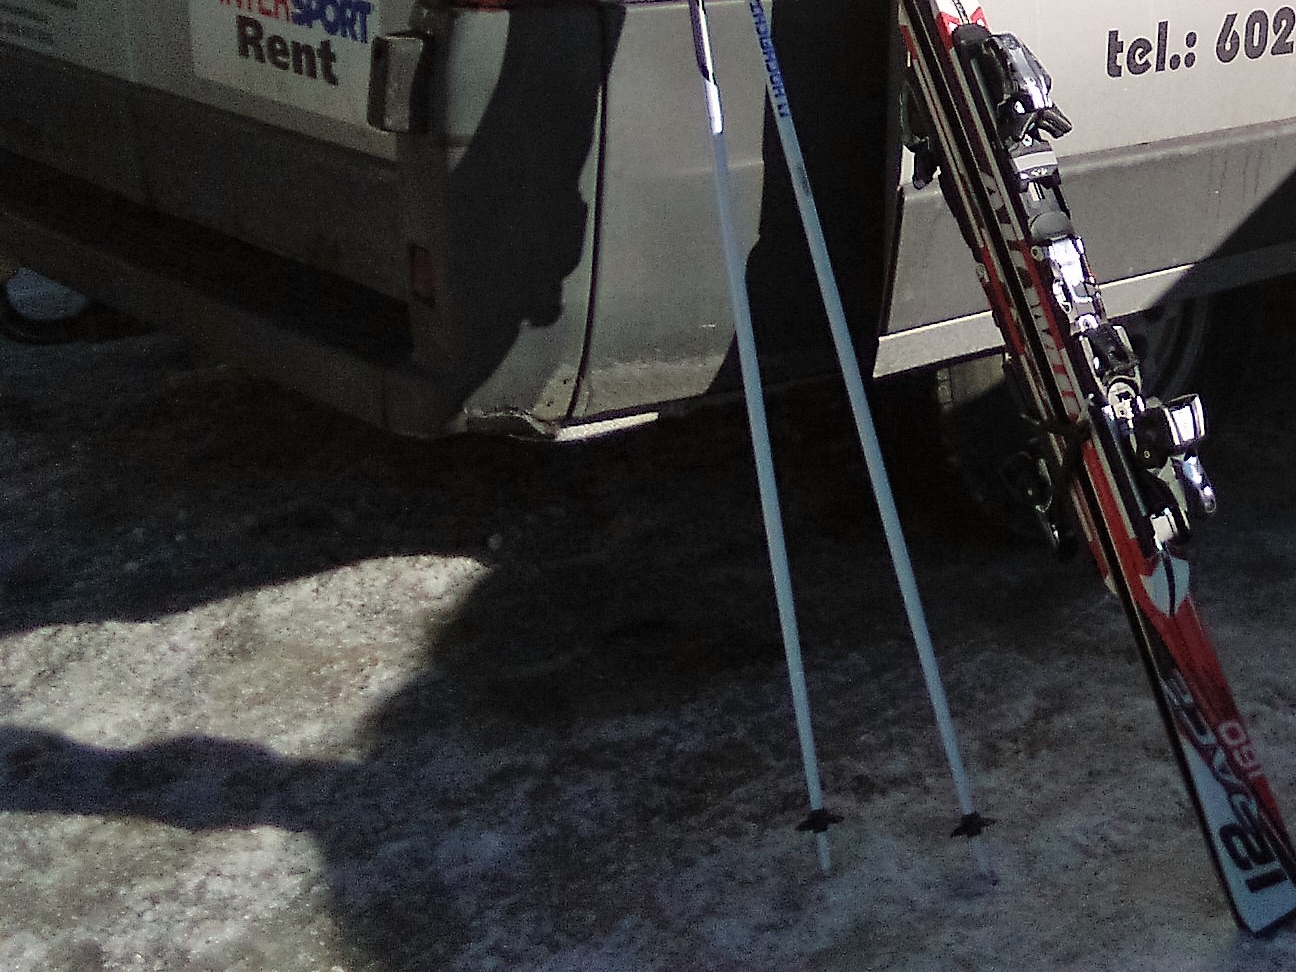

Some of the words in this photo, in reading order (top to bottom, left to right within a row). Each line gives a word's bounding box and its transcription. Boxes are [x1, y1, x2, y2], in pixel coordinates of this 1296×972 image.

[236, 14, 339, 87] Rent
[1106, 20, 1198, 79] tel.:
[1215, 5, 1296, 64] 602
